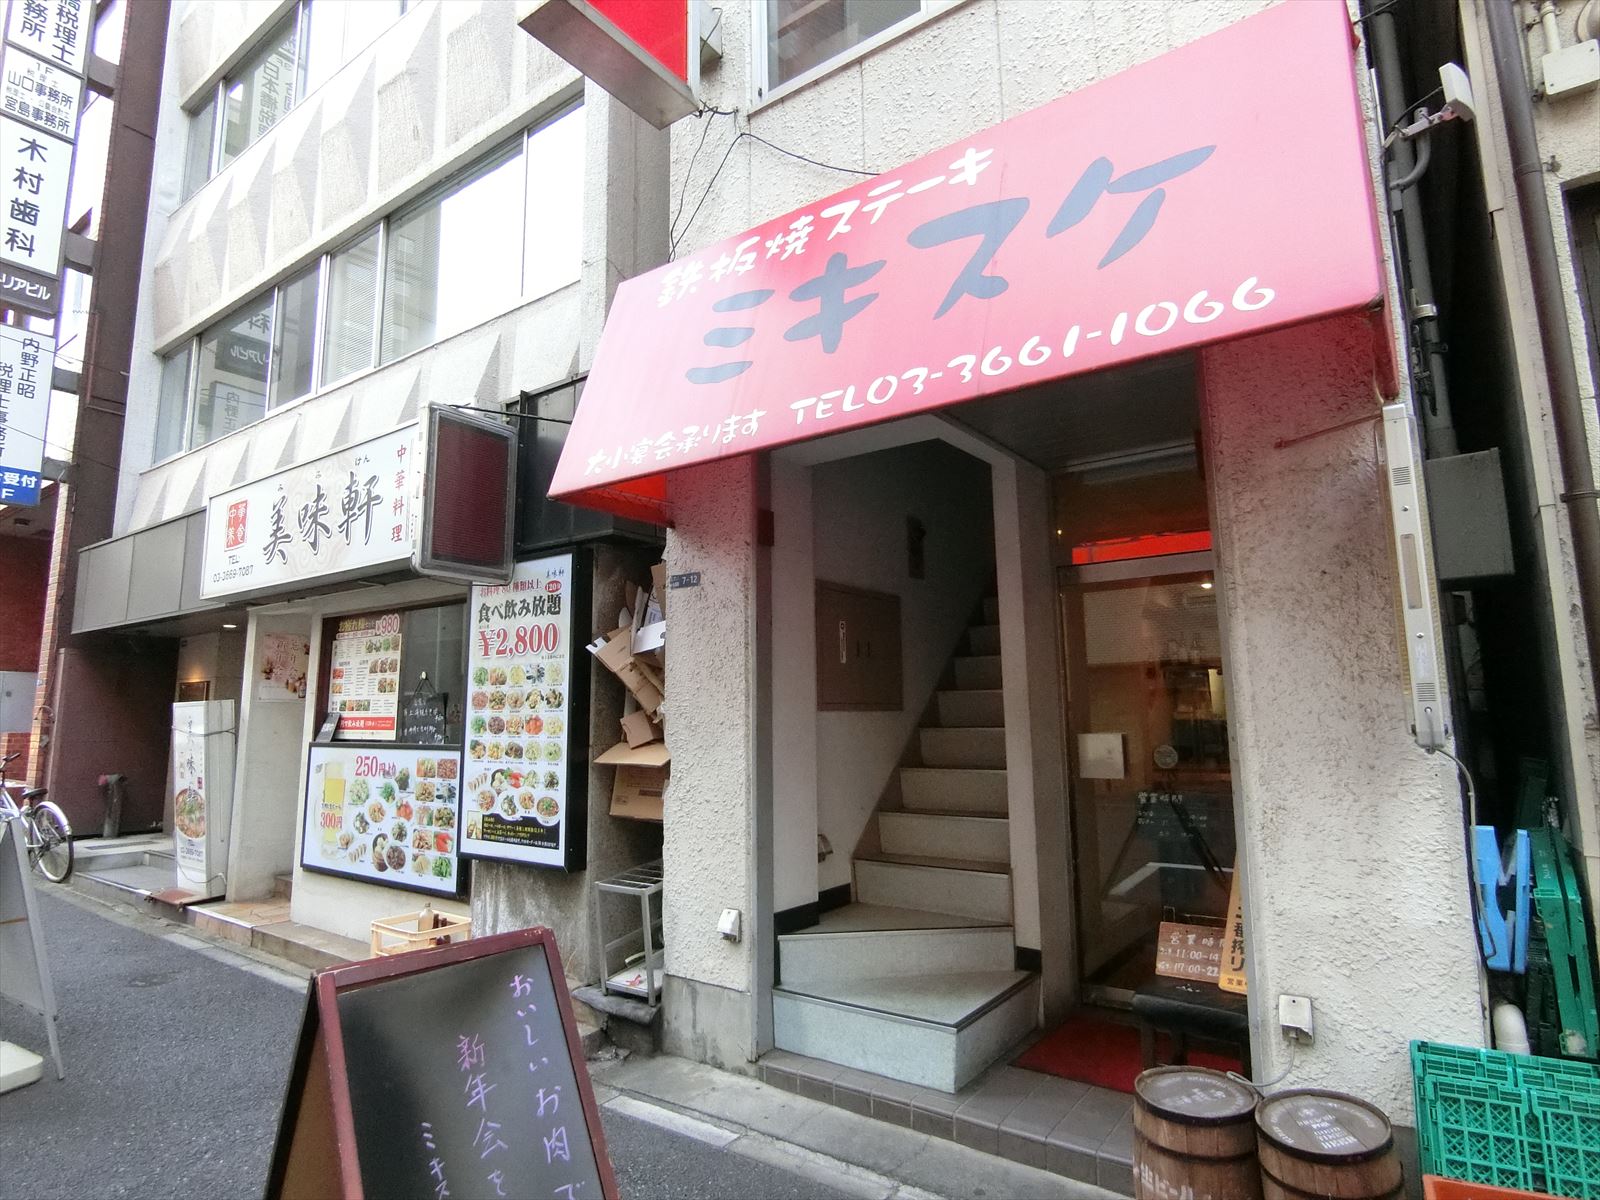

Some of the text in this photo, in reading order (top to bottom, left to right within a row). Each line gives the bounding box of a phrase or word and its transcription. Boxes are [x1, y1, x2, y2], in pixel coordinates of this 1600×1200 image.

[4, 95, 71, 135] 宮島事務所
[7, 69, 74, 110] 山口事務所
[5, 136, 48, 258] 木村歯科
[656, 147, 995, 309] 鉄板焼ステーキ
[0, 272, 51, 300] リアビル
[684, 144, 1217, 385] ミキスケ
[17, 337, 40, 400] 内野正昭
[584, 408, 767, 477] 大小宴会承ります
[0, 470, 38, 489] 受付
[391, 444, 407, 543] 中華料理
[263, 471, 384, 565] 美味軒
[478, 593, 562, 624] 食べ飲み放題
[682, 575, 698, 585] 7-12
[478, 622, 560, 658] ¥2,800
[457, 1033, 509, 1196] 新年会を
